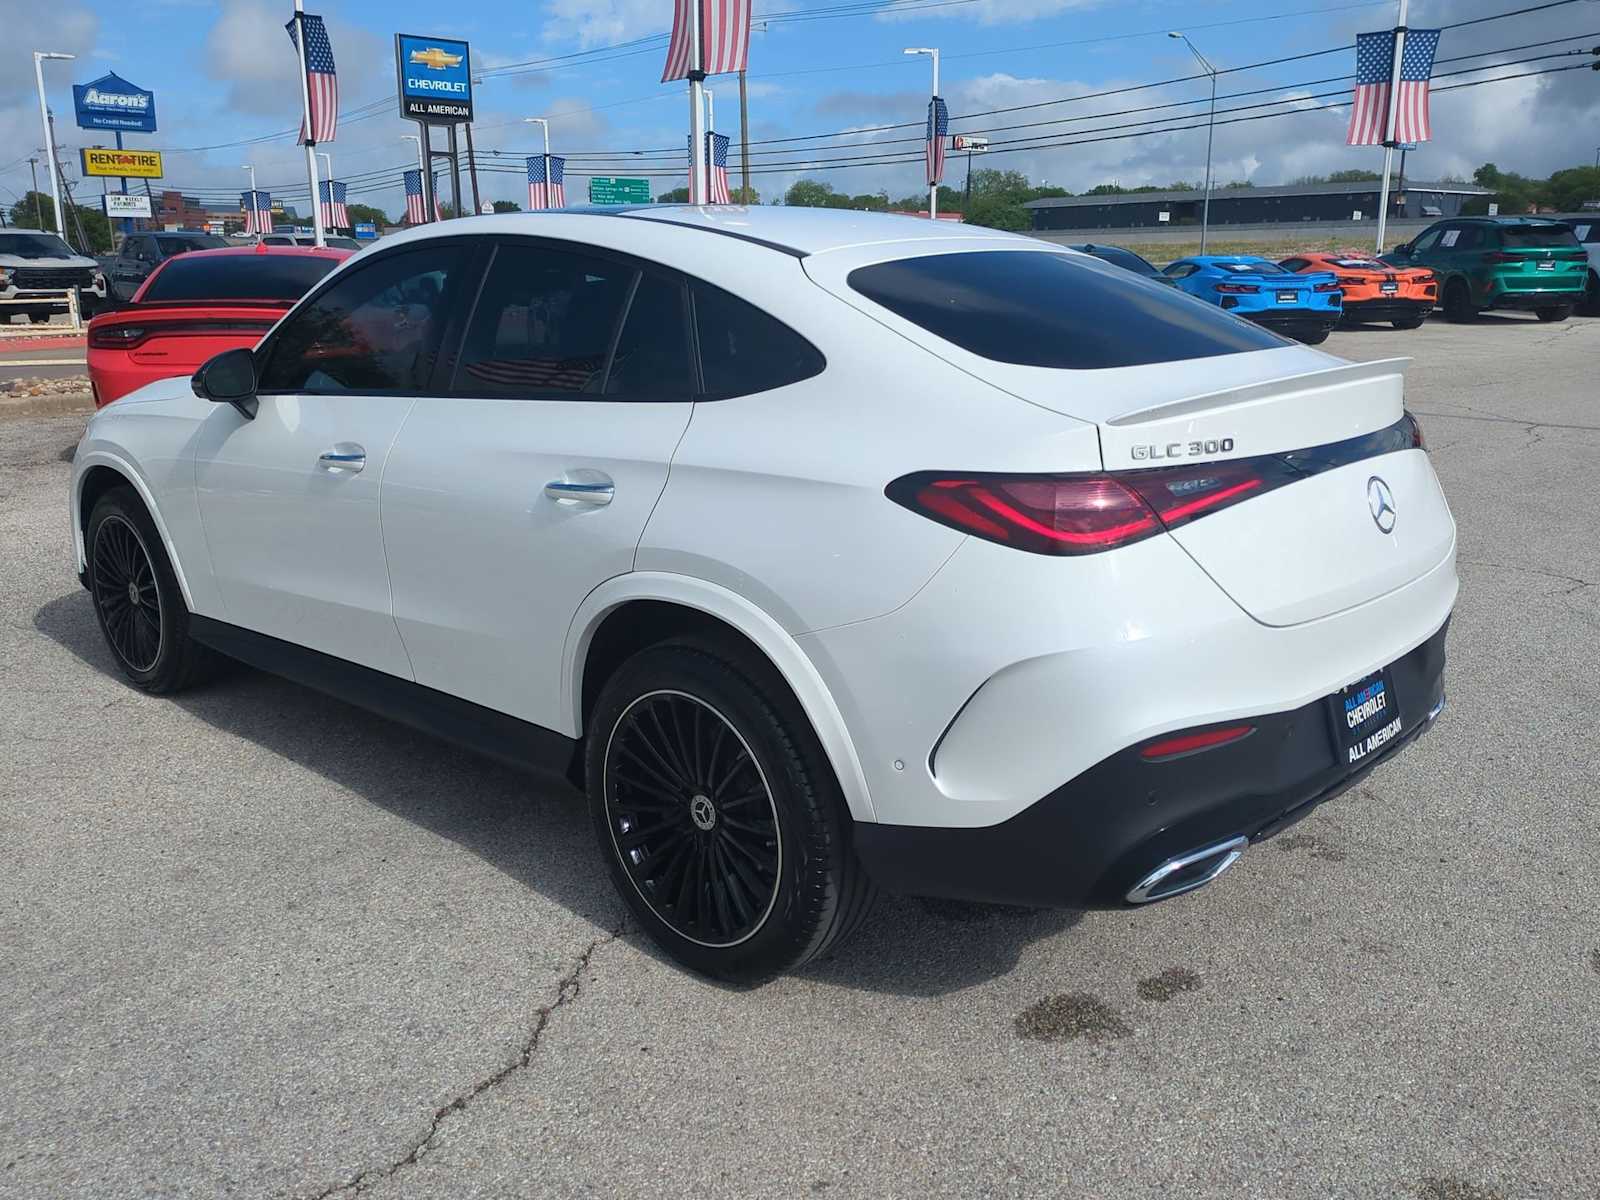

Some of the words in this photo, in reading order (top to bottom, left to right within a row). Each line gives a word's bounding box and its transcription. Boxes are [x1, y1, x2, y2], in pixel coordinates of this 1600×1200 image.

[408, 78, 466, 92] CHEVROLET
[83, 88, 148, 108] Aaron's
[409, 103, 426, 113] ALL
[427, 104, 469, 116] AMERICAN
[1131, 443, 1181, 460] GLC
[1188, 438, 1234, 456] 300
[1346, 691, 1387, 729] CHEVROLET
[1349, 742, 1366, 763] ALL
[1366, 717, 1402, 753] AMERICAN
